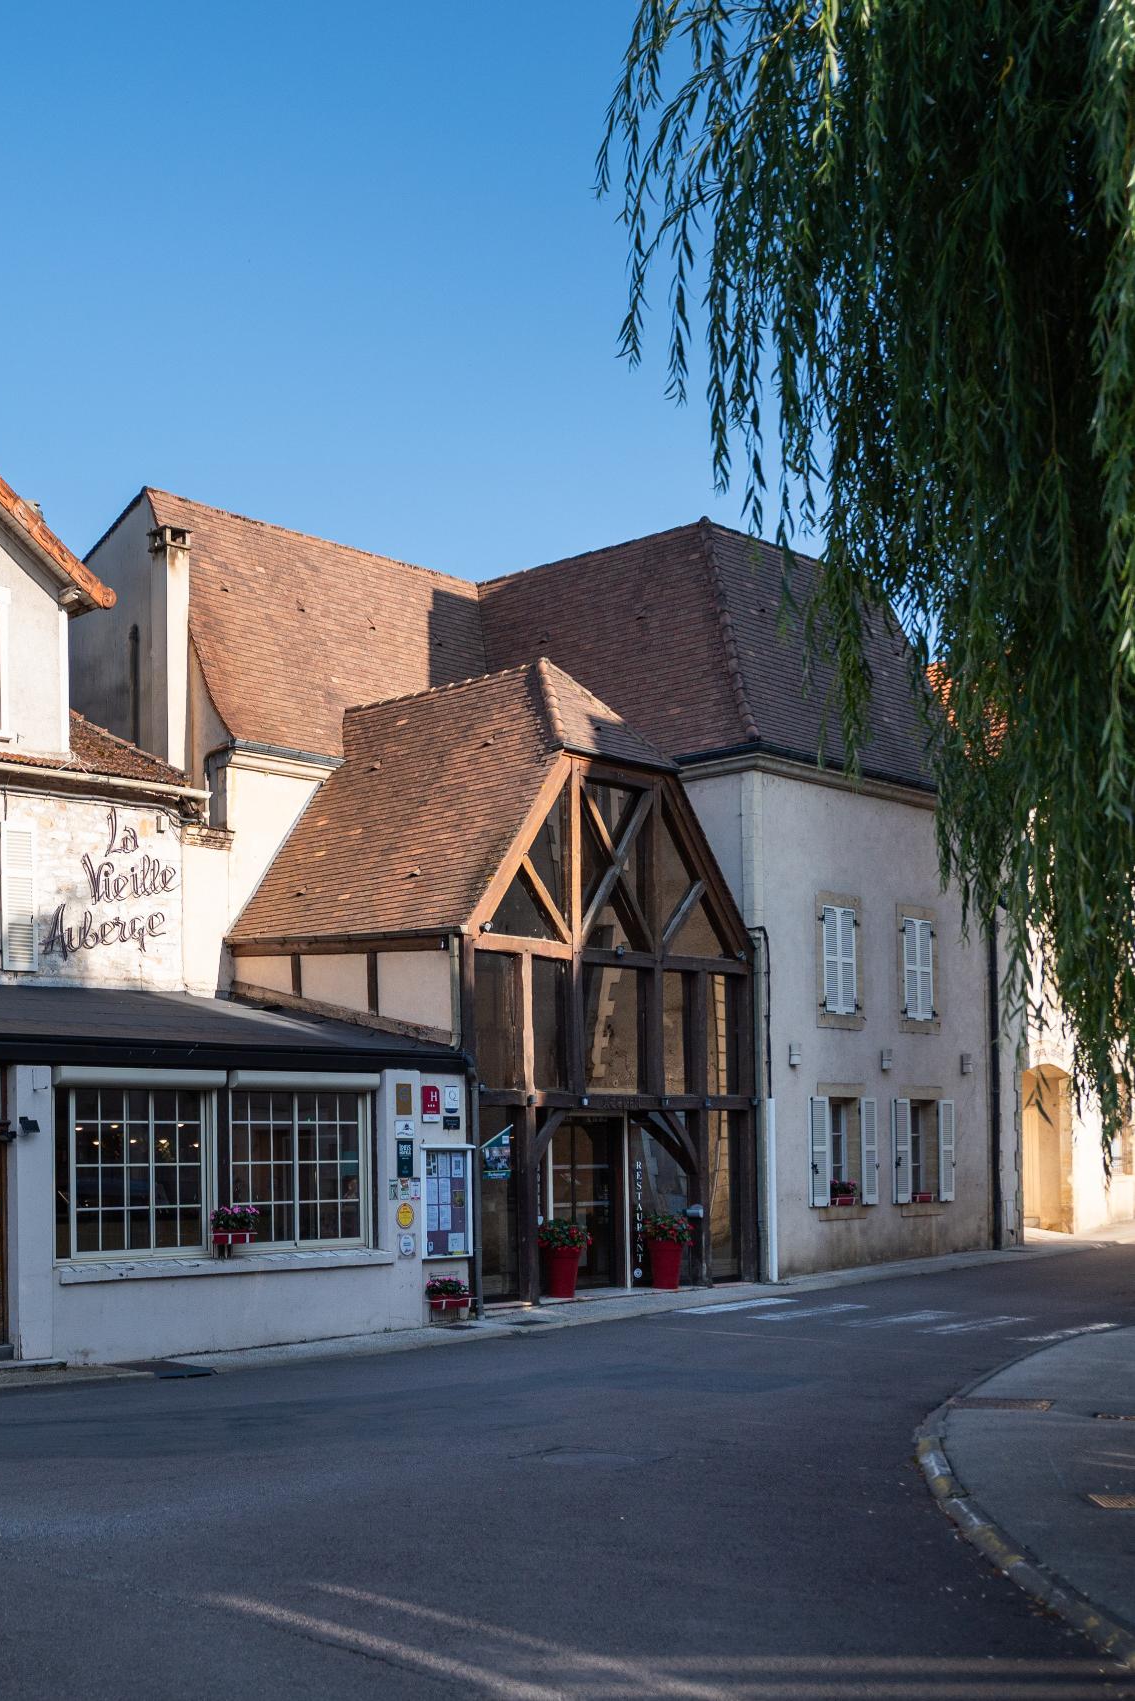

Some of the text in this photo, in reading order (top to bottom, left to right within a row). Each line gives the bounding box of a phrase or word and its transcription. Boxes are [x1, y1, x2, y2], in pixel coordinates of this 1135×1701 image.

[104, 806, 139, 857] La
[80, 853, 181, 905] Vieille
[38, 903, 167, 961] Auberge
[430, 1091, 438, 1102] H
[635, 1160, 645, 1263] RESTAURANT
